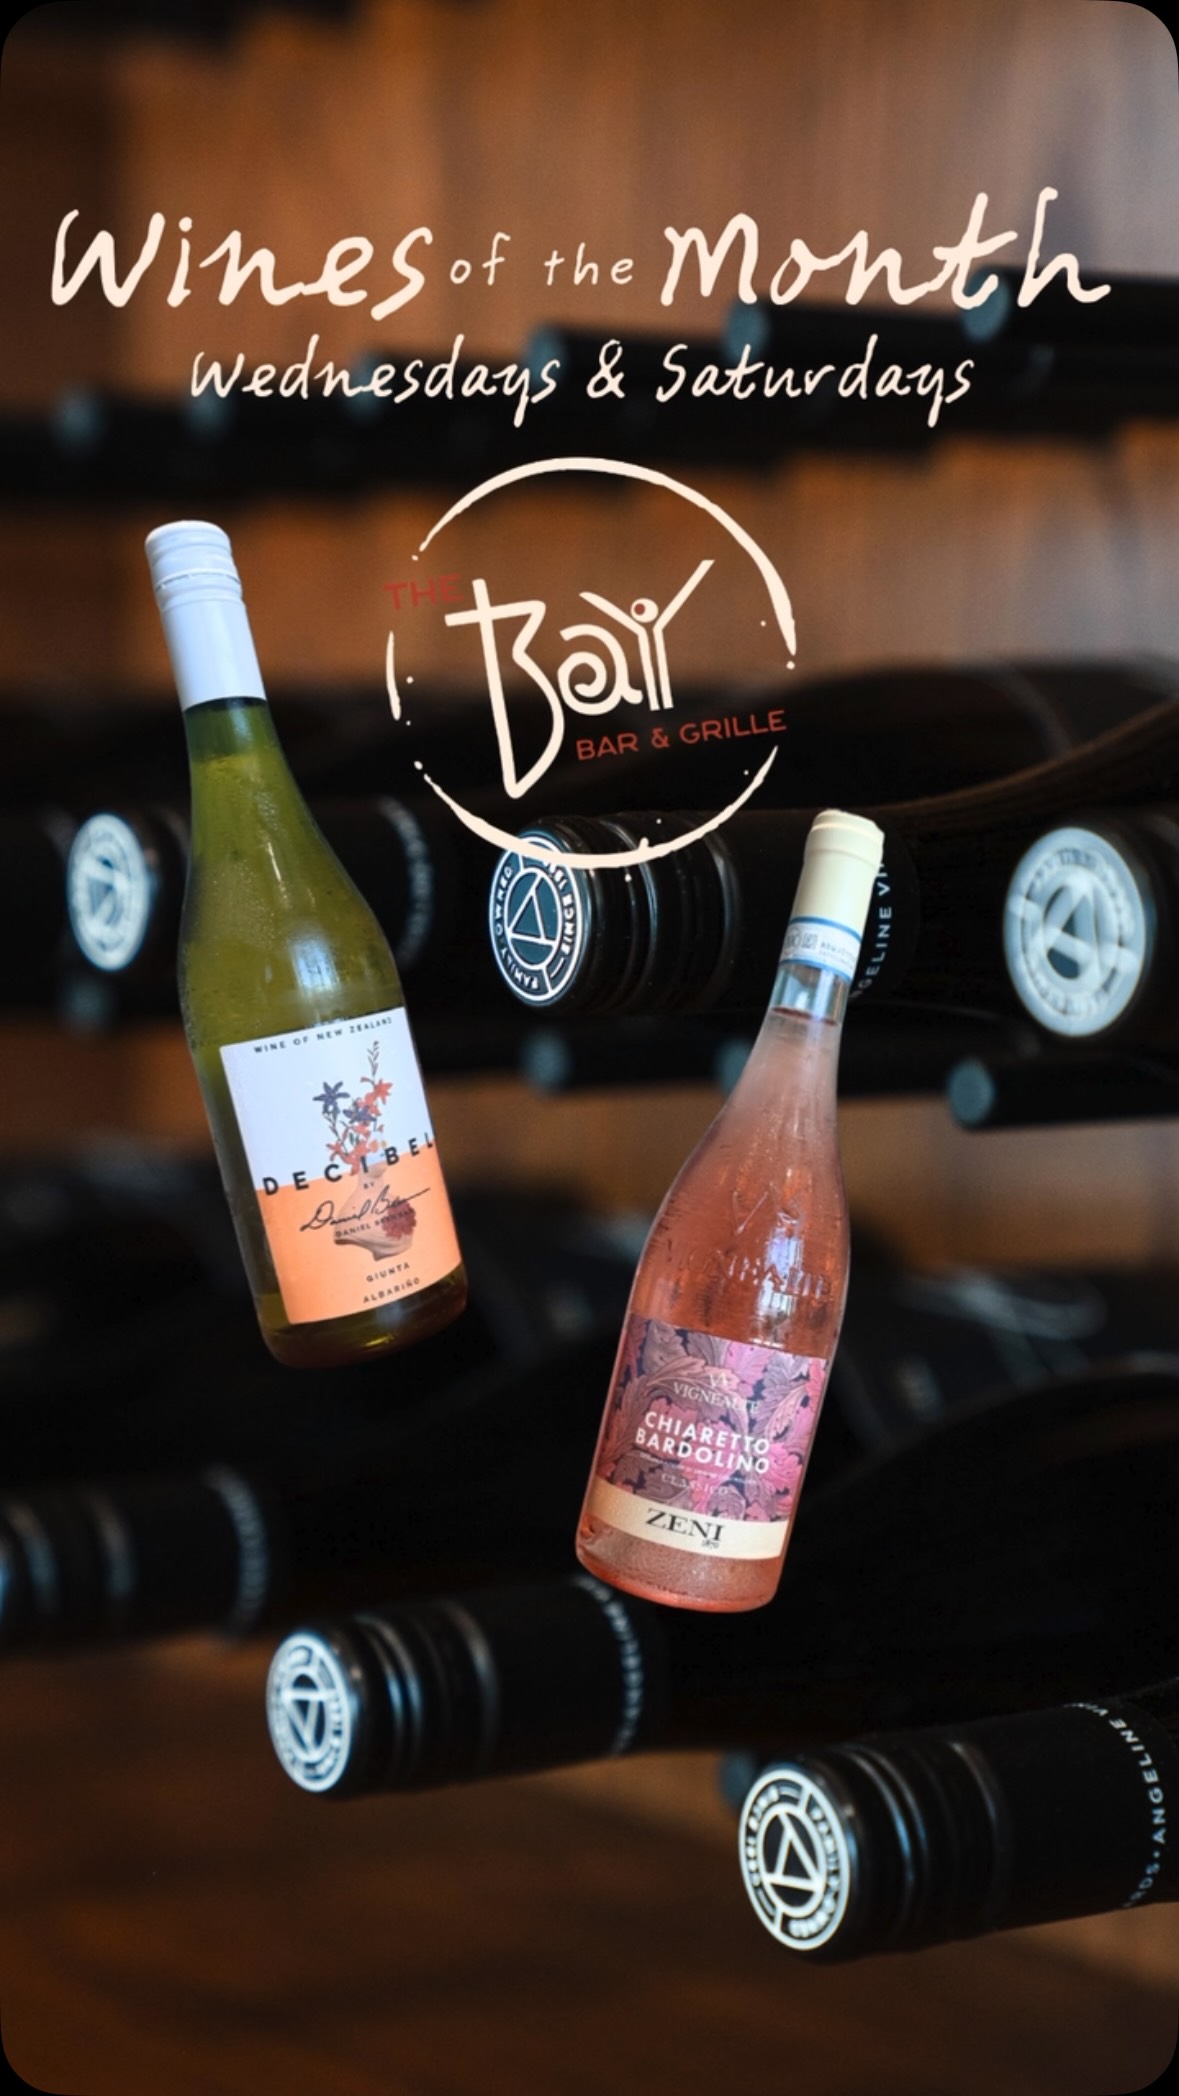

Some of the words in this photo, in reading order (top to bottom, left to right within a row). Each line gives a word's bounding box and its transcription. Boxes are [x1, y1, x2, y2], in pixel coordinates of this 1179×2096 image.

[876, 861, 891, 897] VI
[253, 1040, 287, 1054] WINE
[293, 1034, 310, 1046] OF
[316, 1028, 344, 1041] NEW
[349, 1016, 393, 1034] ZEALAND
[262, 1132, 436, 1197] DECIBEL
[335, 1222, 371, 1238] DANIEL
[362, 1276, 421, 1304] ALBARIÑO
[366, 1262, 411, 1283] GIUNTA
[635, 1427, 770, 1474] BARDOLINO
[644, 1410, 771, 1455] CHIARETTO
[645, 1507, 725, 1542] ZENI
[1108, 1717, 1167, 1845] ANGELINE
